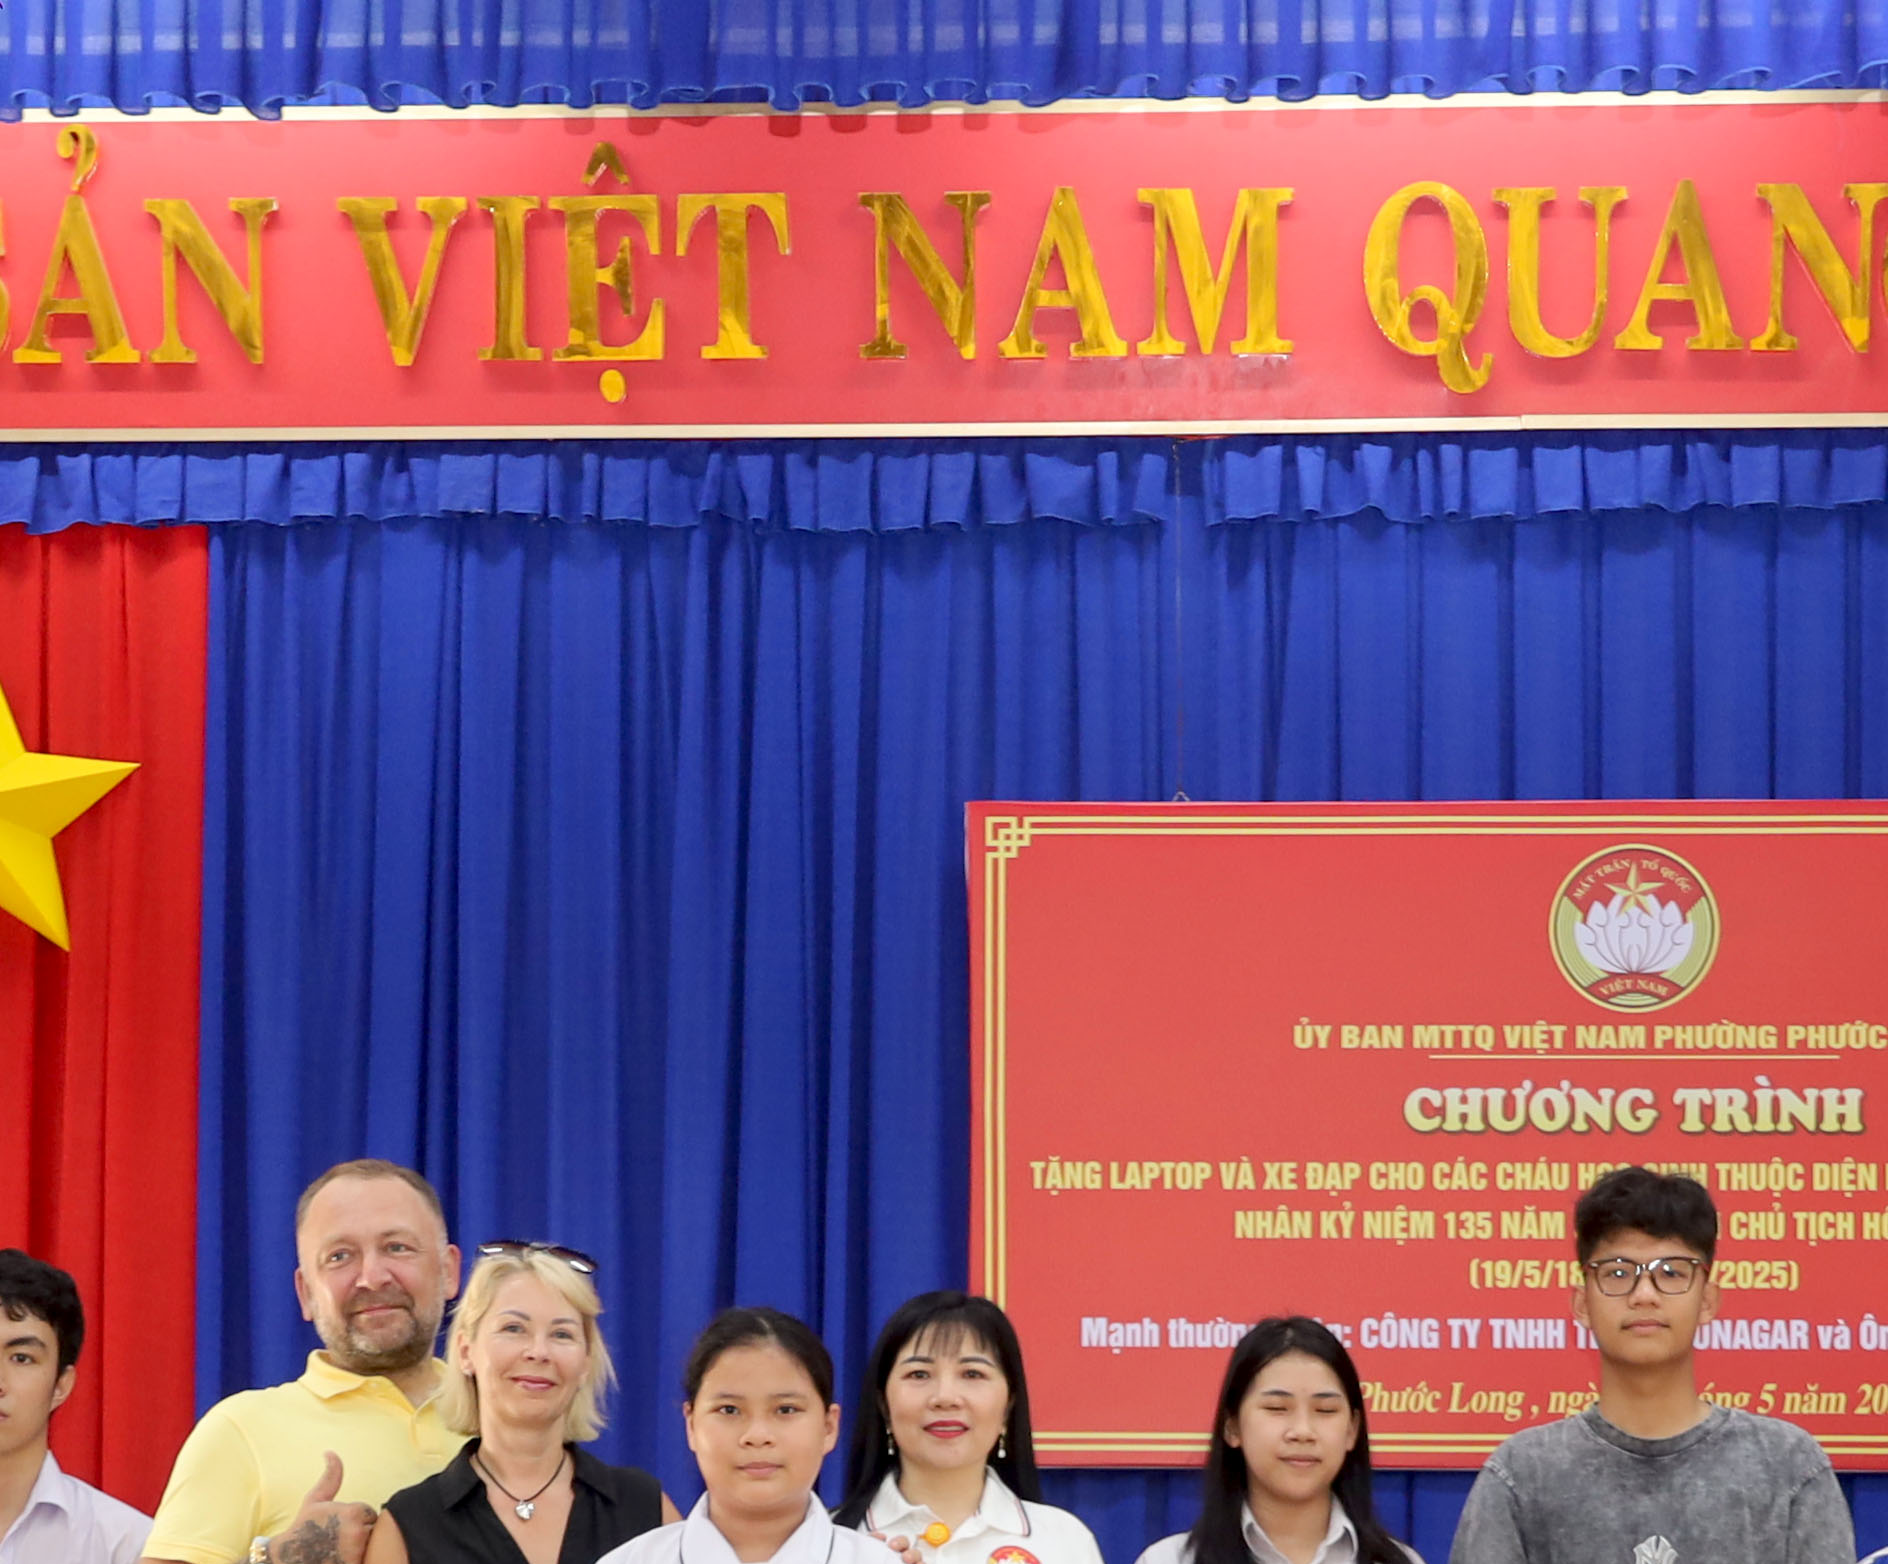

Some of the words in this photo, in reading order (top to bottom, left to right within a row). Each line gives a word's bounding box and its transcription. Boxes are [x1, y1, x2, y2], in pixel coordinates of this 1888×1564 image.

[335, 140, 792, 403] VIỆT
[857, 184, 1296, 361] NAM
[1637, 978, 1670, 996] NAM
[1294, 1017, 1332, 1048] ỦY
[1341, 1025, 1404, 1048] BAN
[1413, 1025, 1494, 1051] MTTQ
[1503, 1020, 1567, 1054] VIỆT
[1576, 1025, 1646, 1049] NAM
[1654, 1020, 1778, 1049] PHƯỜNG
[1787, 1021, 1888, 1049] PHƯỚC
[1404, 1080, 1658, 1132] CHƯƠNG
[1673, 1075, 1863, 1132] TRÌNH
[1030, 1156, 1102, 1195] TẶNG
[1110, 1161, 1212, 1190] LAPTOP
[1219, 1156, 1256, 1190] VÀ
[1263, 1162, 1298, 1190] XE
[1305, 1162, 1361, 1196] ĐẠP
[1369, 1162, 1425, 1190] CHO
[1433, 1156, 1488, 1190] CÁC
[1496, 1157, 1570, 1190] CHÁU
[1715, 1157, 1804, 1197] THUỘC
[1813, 1157, 1877, 1197] DIỆN
[1235, 1205, 1312, 1239] NHÂN
[1320, 1201, 1355, 1239] KỶ
[1363, 1205, 1435, 1245] NIỆM
[1443, 1211, 1493, 1239] 135
[1501, 1206, 1565, 1239] NĂM
[1730, 1203, 1785, 1240] CHỦ
[1793, 1212, 1854, 1246] TỊCH
[1081, 1317, 1160, 1354] Mạnh
[1167, 1316, 1256, 1349] thườn
[1360, 1312, 1439, 1348] CÔNG
[1447, 1318, 1481, 1348] TY
[1489, 1318, 1565, 1349] TNHH
[1816, 1314, 1851, 1350] và
[1448, 1382, 1525, 1421] Long
[1547, 1381, 1601, 1418] ngà
[1756, 1383, 1777, 1415] 5
[1783, 1384, 1846, 1414] năm
